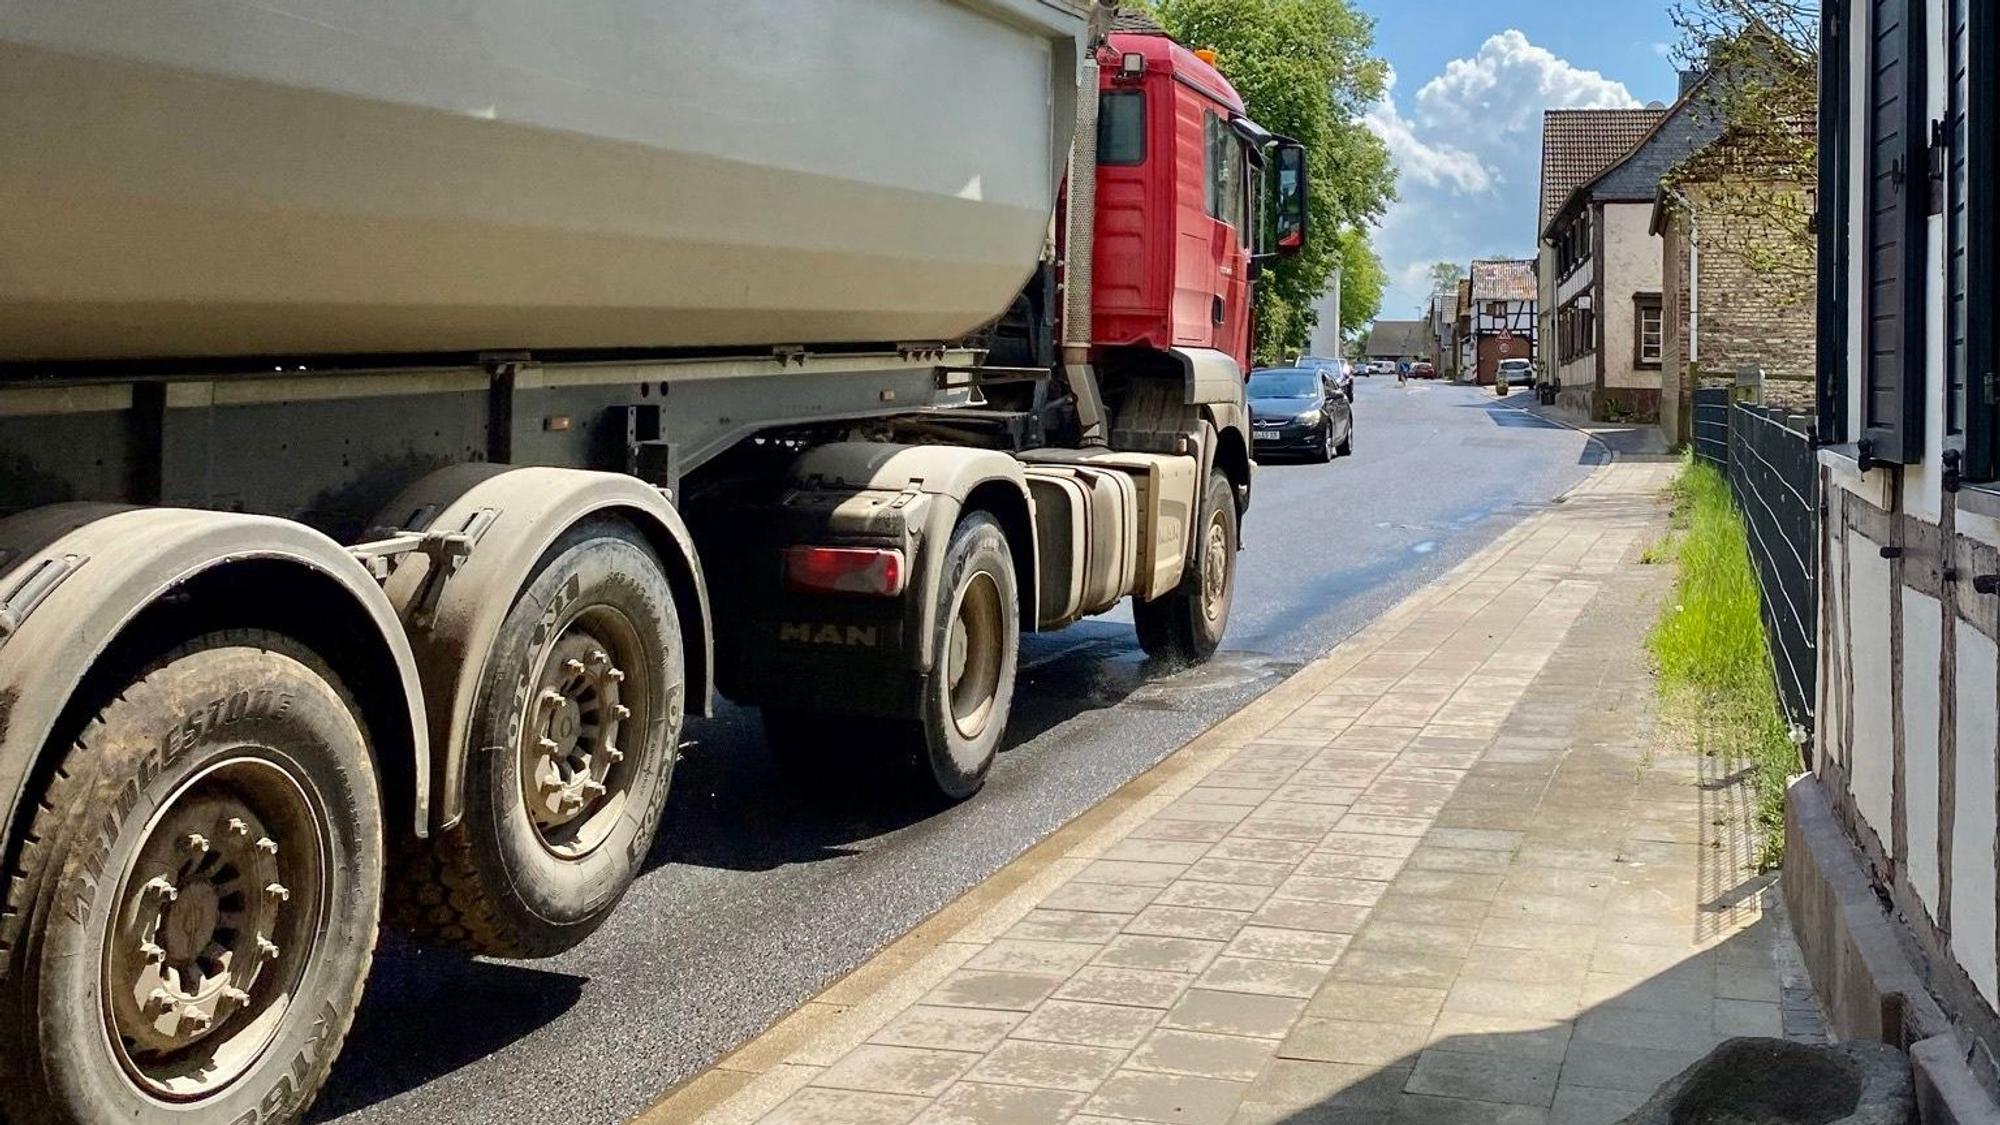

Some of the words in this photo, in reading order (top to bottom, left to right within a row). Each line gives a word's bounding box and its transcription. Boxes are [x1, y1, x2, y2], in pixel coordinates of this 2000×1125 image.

[508, 583, 571, 748] OTANI
[779, 622, 877, 647] MAN
[67, 688, 297, 932] BRIDGESTONE
